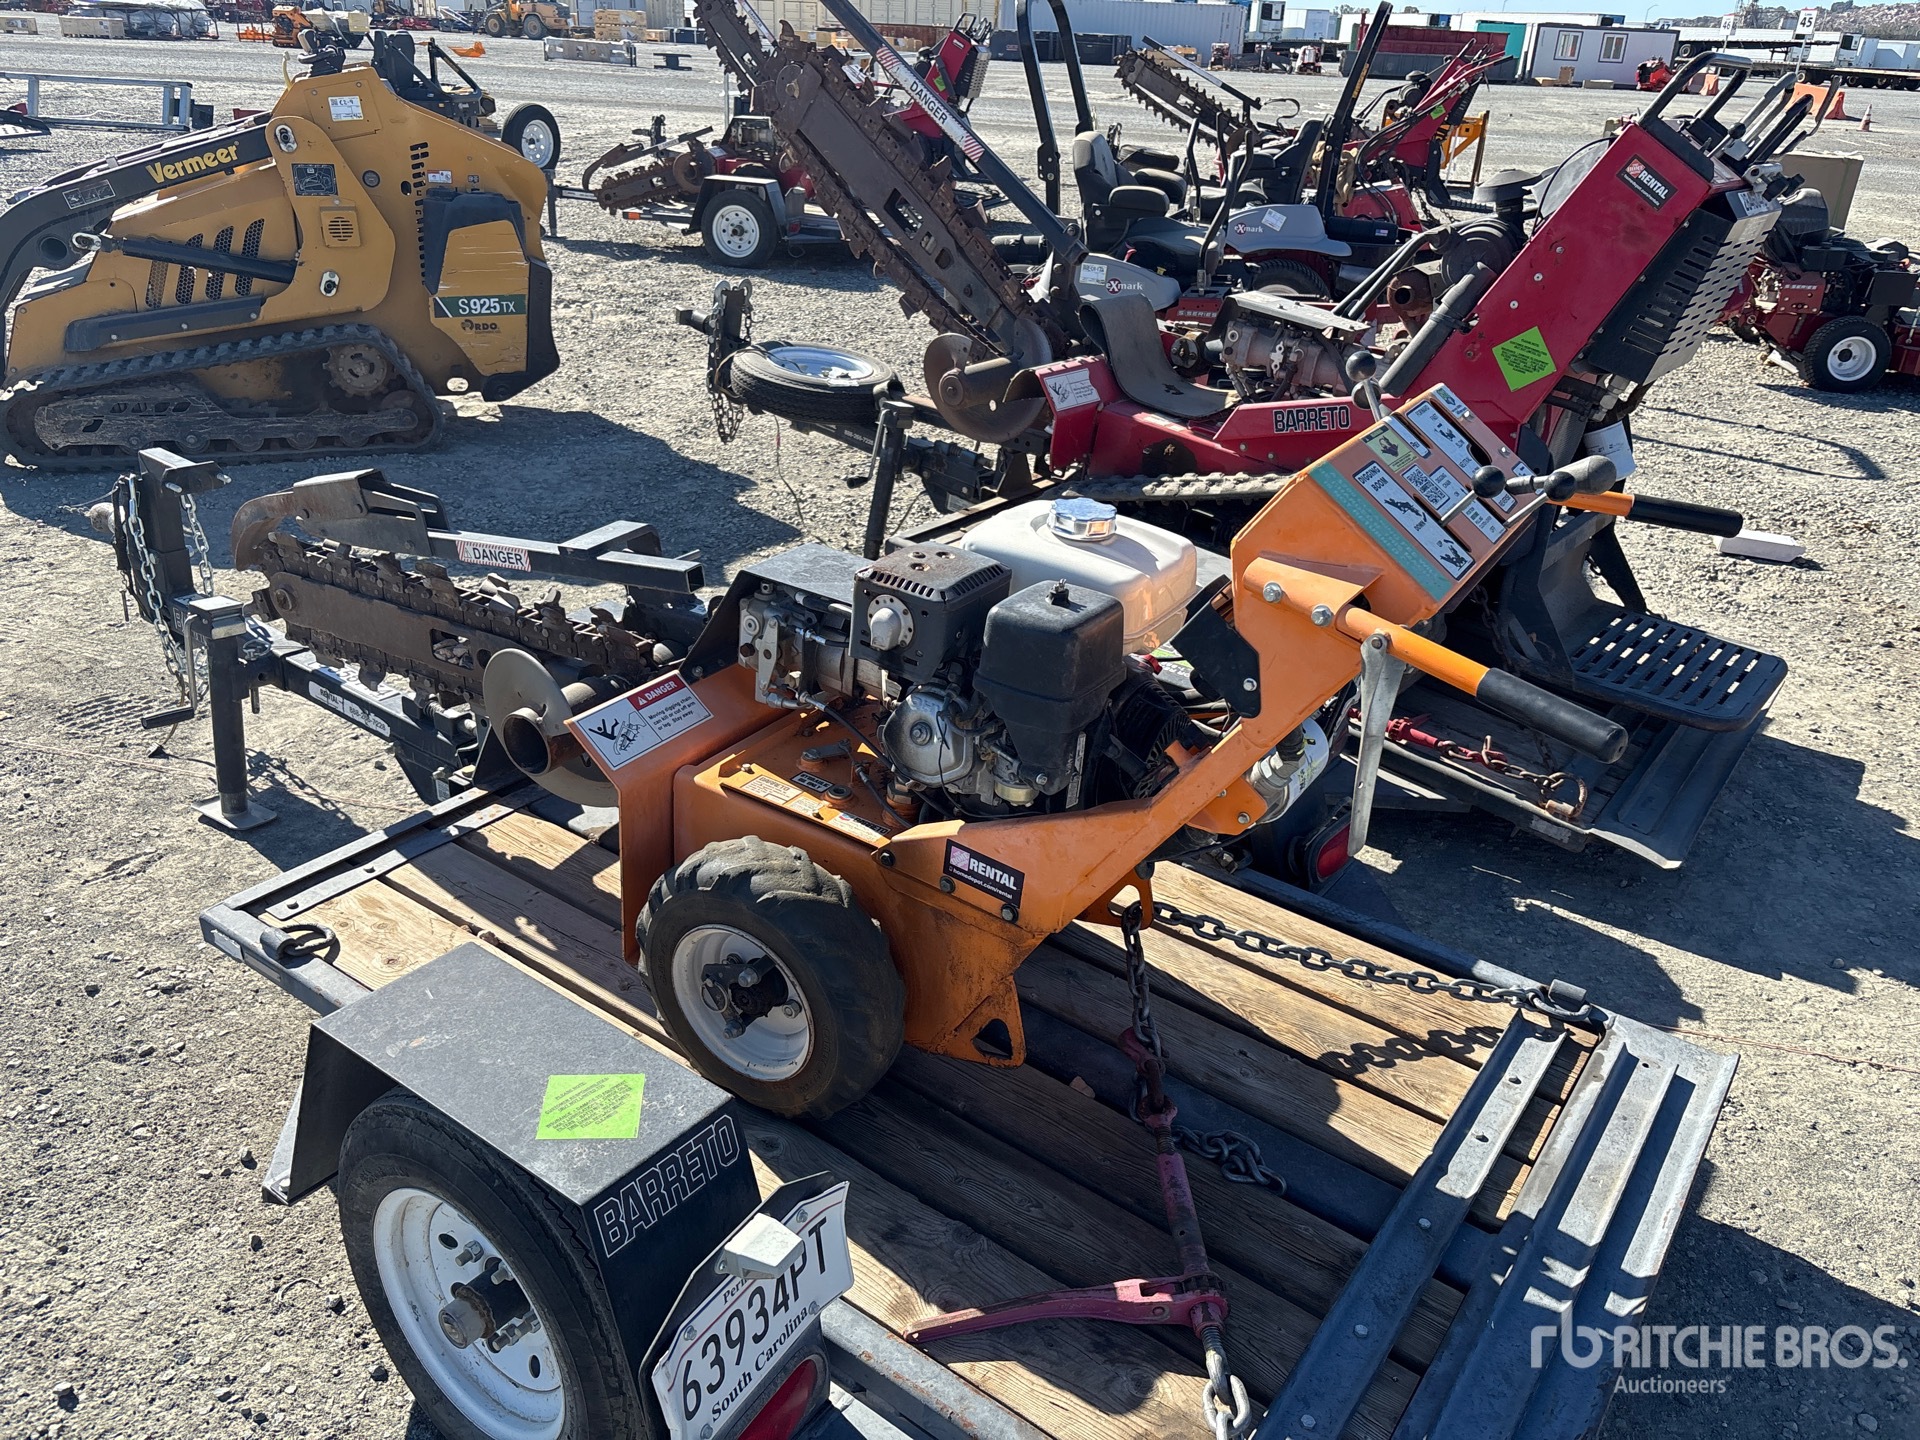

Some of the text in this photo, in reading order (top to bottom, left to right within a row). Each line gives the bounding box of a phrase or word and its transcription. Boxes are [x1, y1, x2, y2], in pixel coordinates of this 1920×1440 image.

[1800, 17, 1813, 28] 45
[911, 80, 948, 125] DANGER
[146, 144, 238, 184] Vermeer
[1638, 170, 1670, 200] RENTAL
[1234, 224, 1263, 234] eXmark
[1105, 279, 1143, 292] eXmark
[1186, 310, 1217, 318] SERIES
[474, 322, 498, 331] RDO
[1273, 405, 1351, 434] BARRETO
[1357, 465, 1381, 485] DIGGING
[1370, 476, 1389, 492] BOOM
[1413, 519, 1427, 532] DOWN
[473, 547, 525, 567] DANGER
[644, 680, 678, 701] DANGER
[647, 695, 692, 721] Moving digging chain
[671, 715, 683, 724] Stay
[682, 710, 694, 719] away.
[969, 857, 1017, 891] RENTAL
[593, 1114, 740, 1259] BARRETO
[682, 1216, 827, 1421] 63934PT
[711, 1372, 753, 1423] South
[754, 1305, 809, 1372] Carolina
